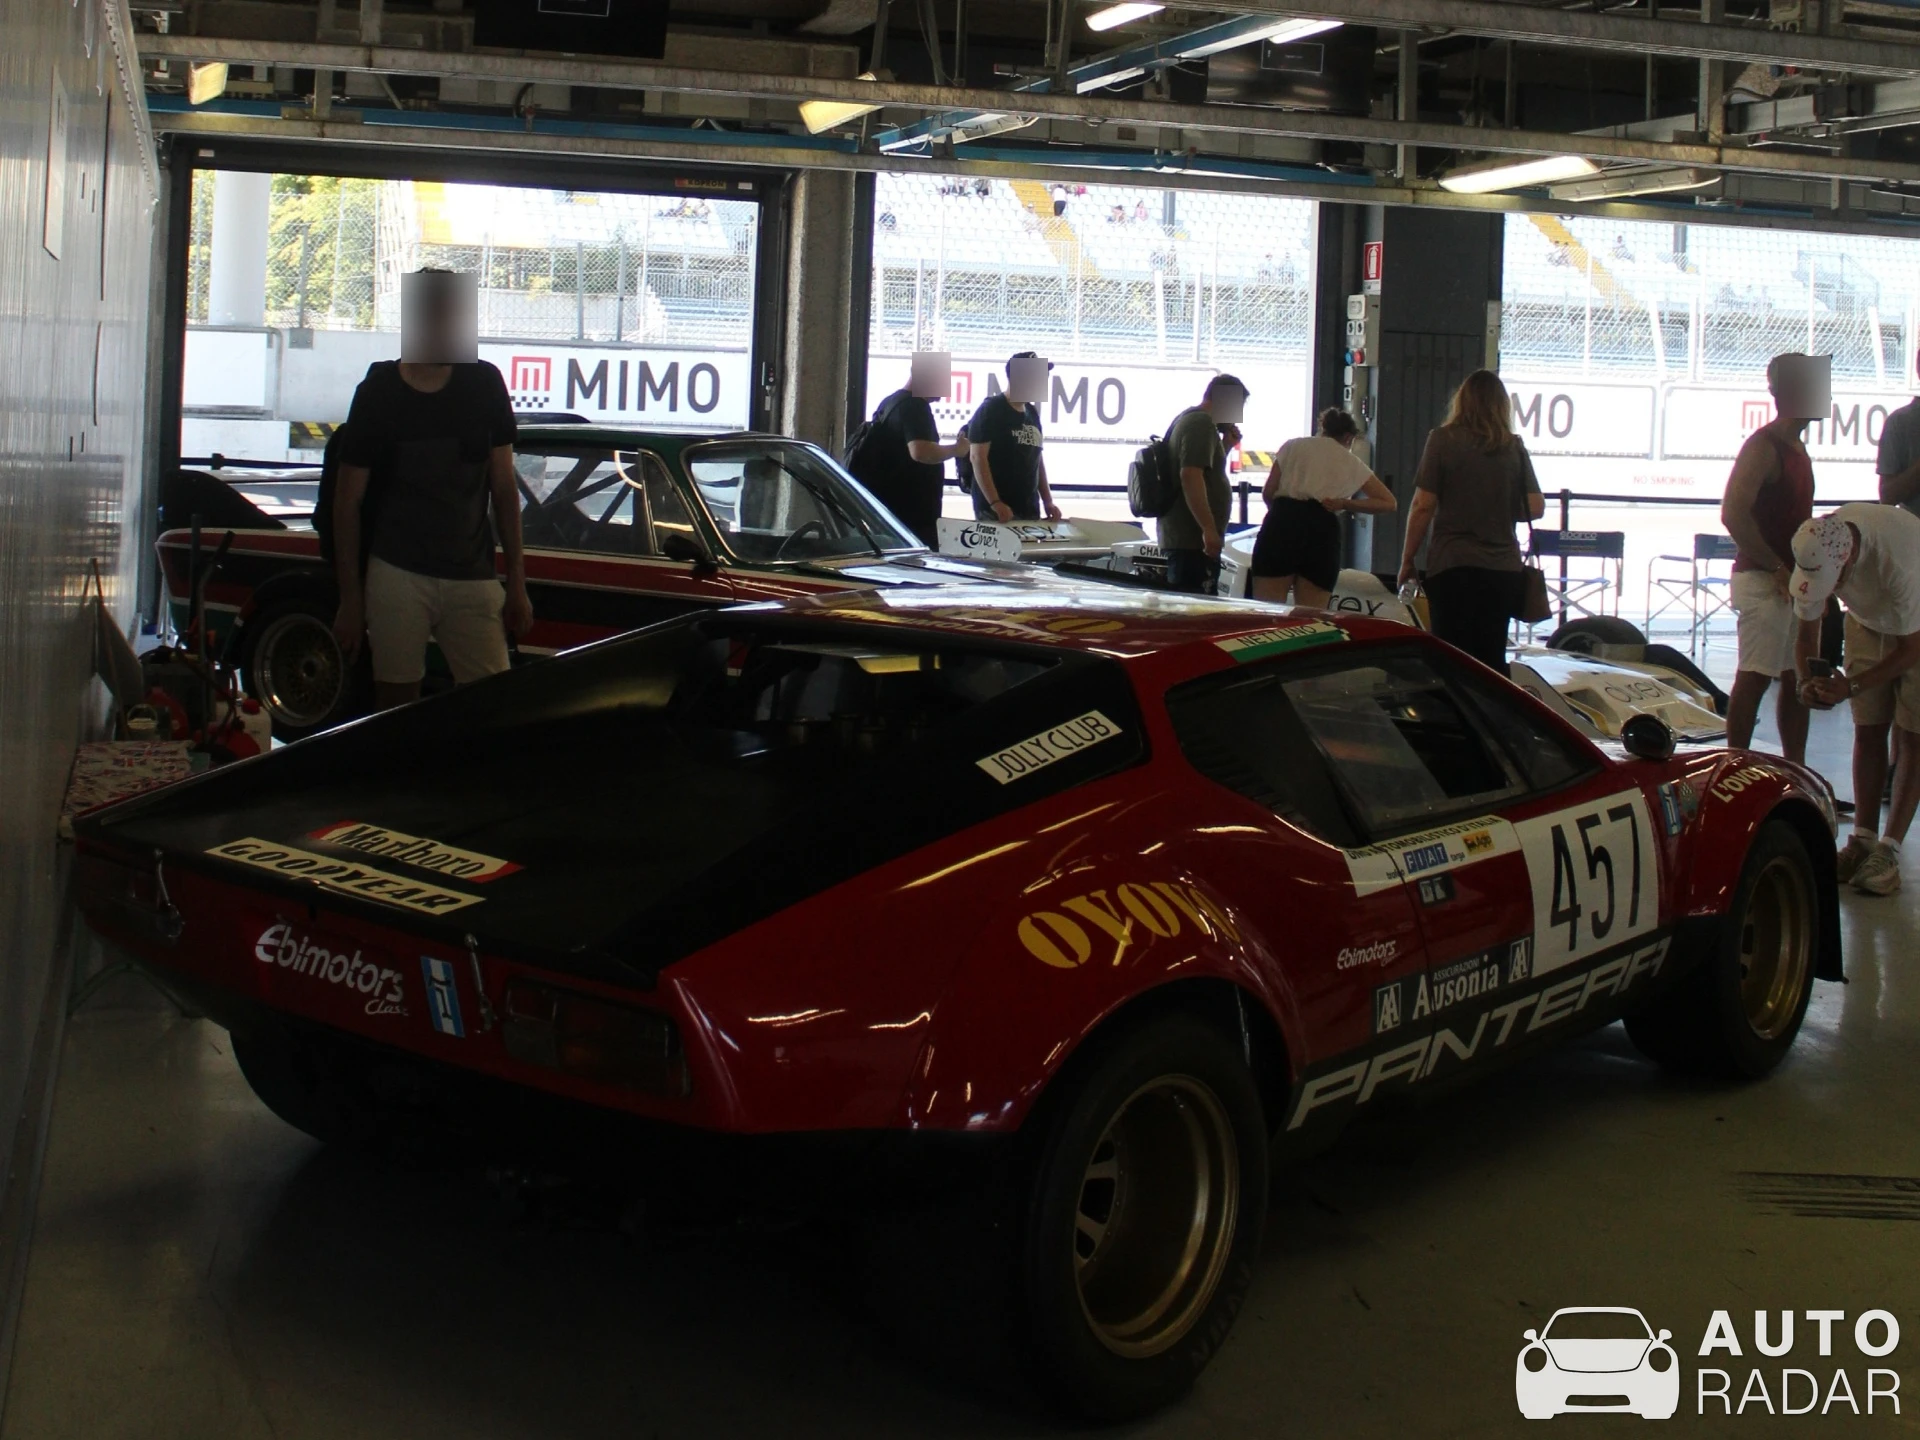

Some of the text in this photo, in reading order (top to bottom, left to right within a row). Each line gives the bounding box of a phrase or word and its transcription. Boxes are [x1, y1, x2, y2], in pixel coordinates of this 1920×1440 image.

[566, 358, 720, 413] MIMO
[1511, 393, 1574, 439] MO
[1651, 474, 1695, 487] SMOKING
[975, 523, 996, 535] France
[1236, 625, 1317, 647] NETTUNO
[991, 716, 1110, 779] JOLLY CLUB
[220, 844, 463, 909] GOODYEAR
[328, 825, 487, 876] Marlboro
[1405, 844, 1447, 871] FIAT
[1550, 803, 1640, 952] 457
[255, 923, 404, 1001] Ebimotors
[1336, 940, 1397, 970] Ebimotors
[1412, 954, 1499, 1021] Ausonia
[1286, 936, 1673, 1132] PANTERA
